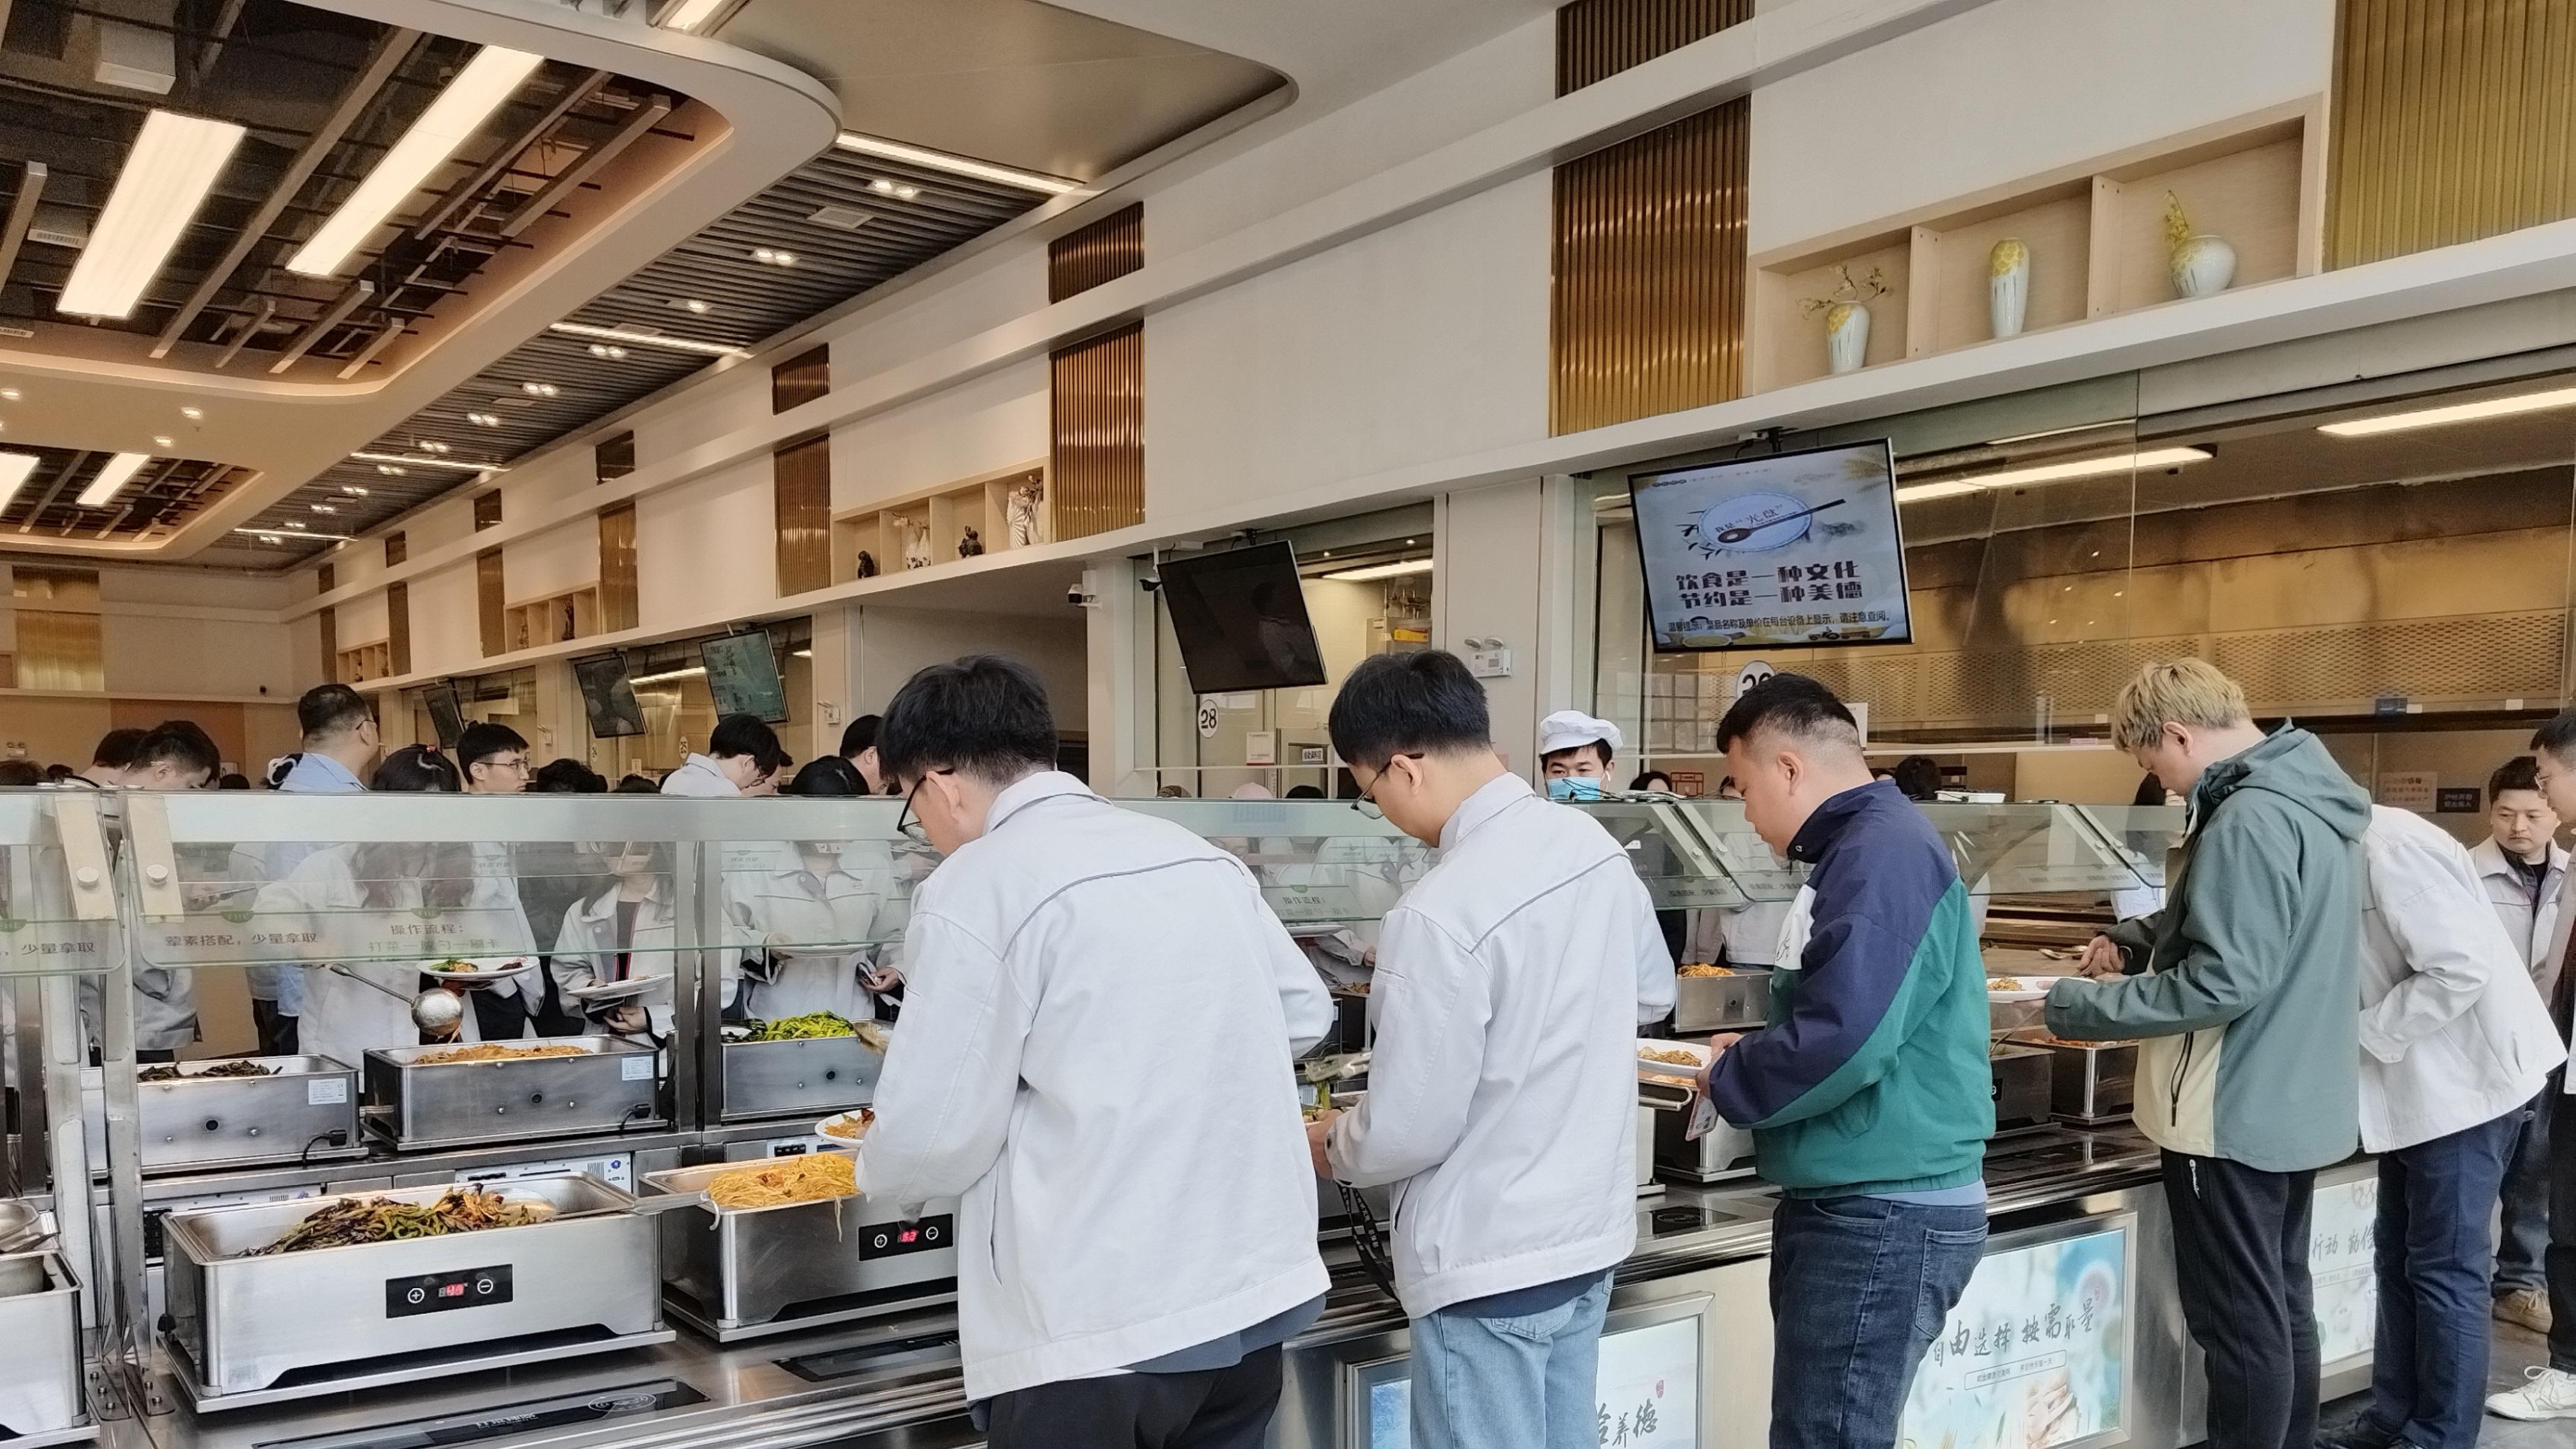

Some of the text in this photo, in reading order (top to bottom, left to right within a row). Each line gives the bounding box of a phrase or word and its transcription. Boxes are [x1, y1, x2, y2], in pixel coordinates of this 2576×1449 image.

[1675, 560, 1861, 591] 饮食是一种文化
[1679, 581, 1864, 610] 节约是一种美德
[1200, 708, 1217, 729] 28
[391, 924, 464, 935] 操作流程：
[1933, 1297, 2096, 1368] 自由选择 按需取量
